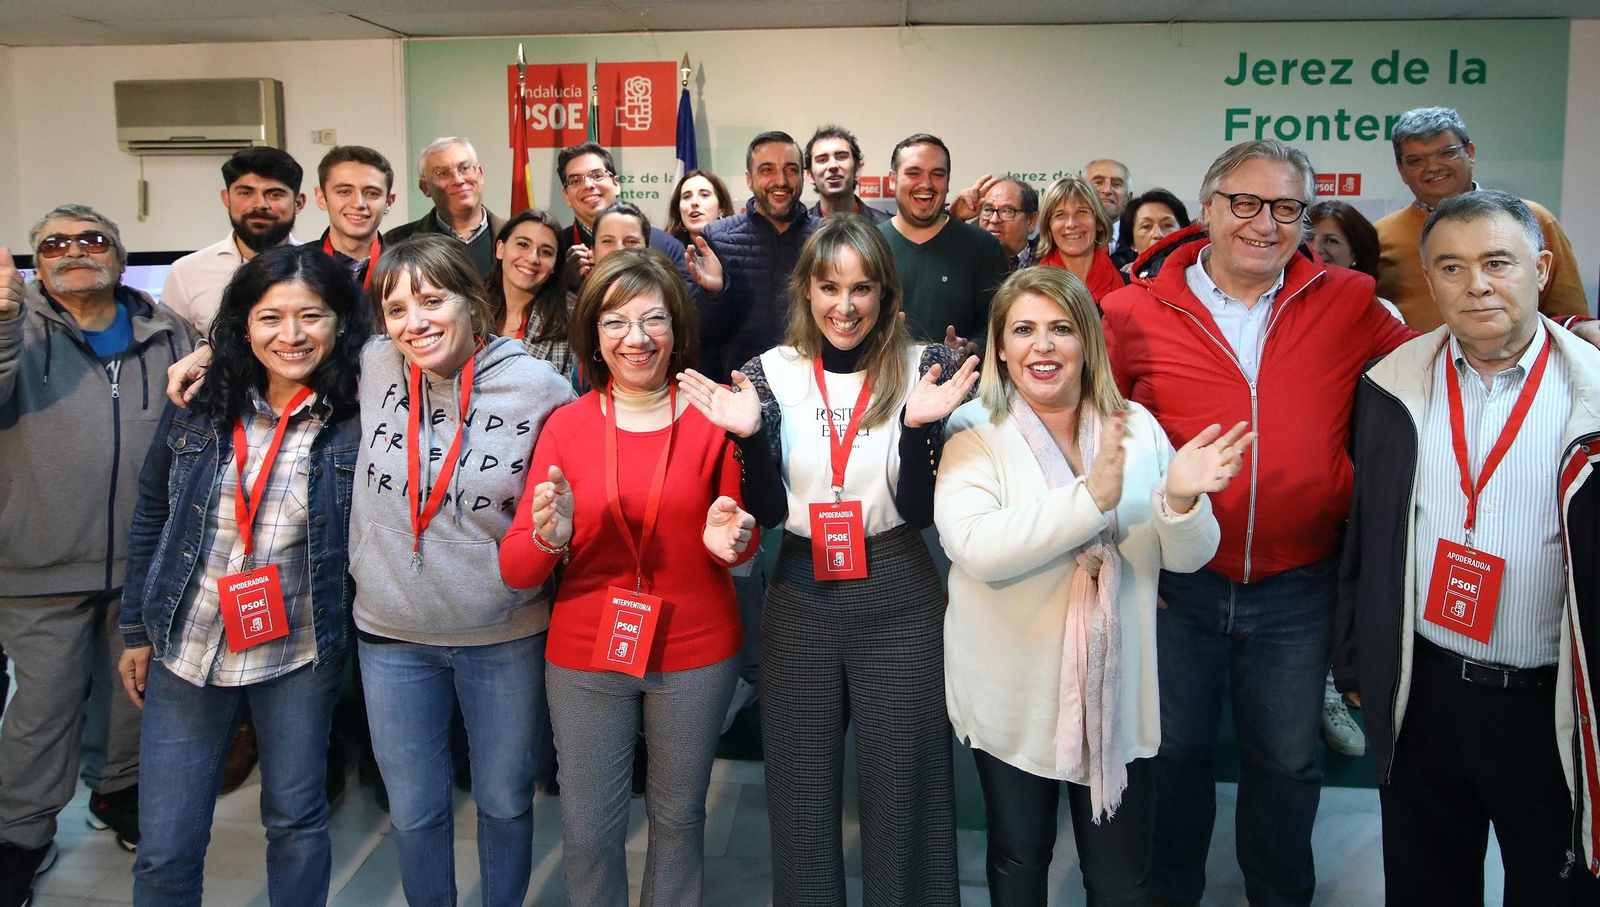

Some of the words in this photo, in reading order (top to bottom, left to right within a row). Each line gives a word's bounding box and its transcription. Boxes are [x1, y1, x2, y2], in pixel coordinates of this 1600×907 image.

[1224, 52, 1353, 86] Jerez
[1371, 49, 1429, 85] de
[1448, 49, 1486, 85] la
[1224, 108, 1400, 142] Fronter
[641, 173, 659, 184] de
[861, 185, 879, 194] PSOE
[819, 511, 854, 519] APODERADO/A
[827, 533, 849, 542] PSOE
[1446, 551, 1491, 572] APODERADO/A
[229, 575, 270, 592] APODERADO/A
[1451, 578, 1477, 593] PSOE
[241, 598, 266, 613] PSOE
[612, 597, 652, 612] INTERVENTOR/A
[616, 621, 639, 634] PSOE
